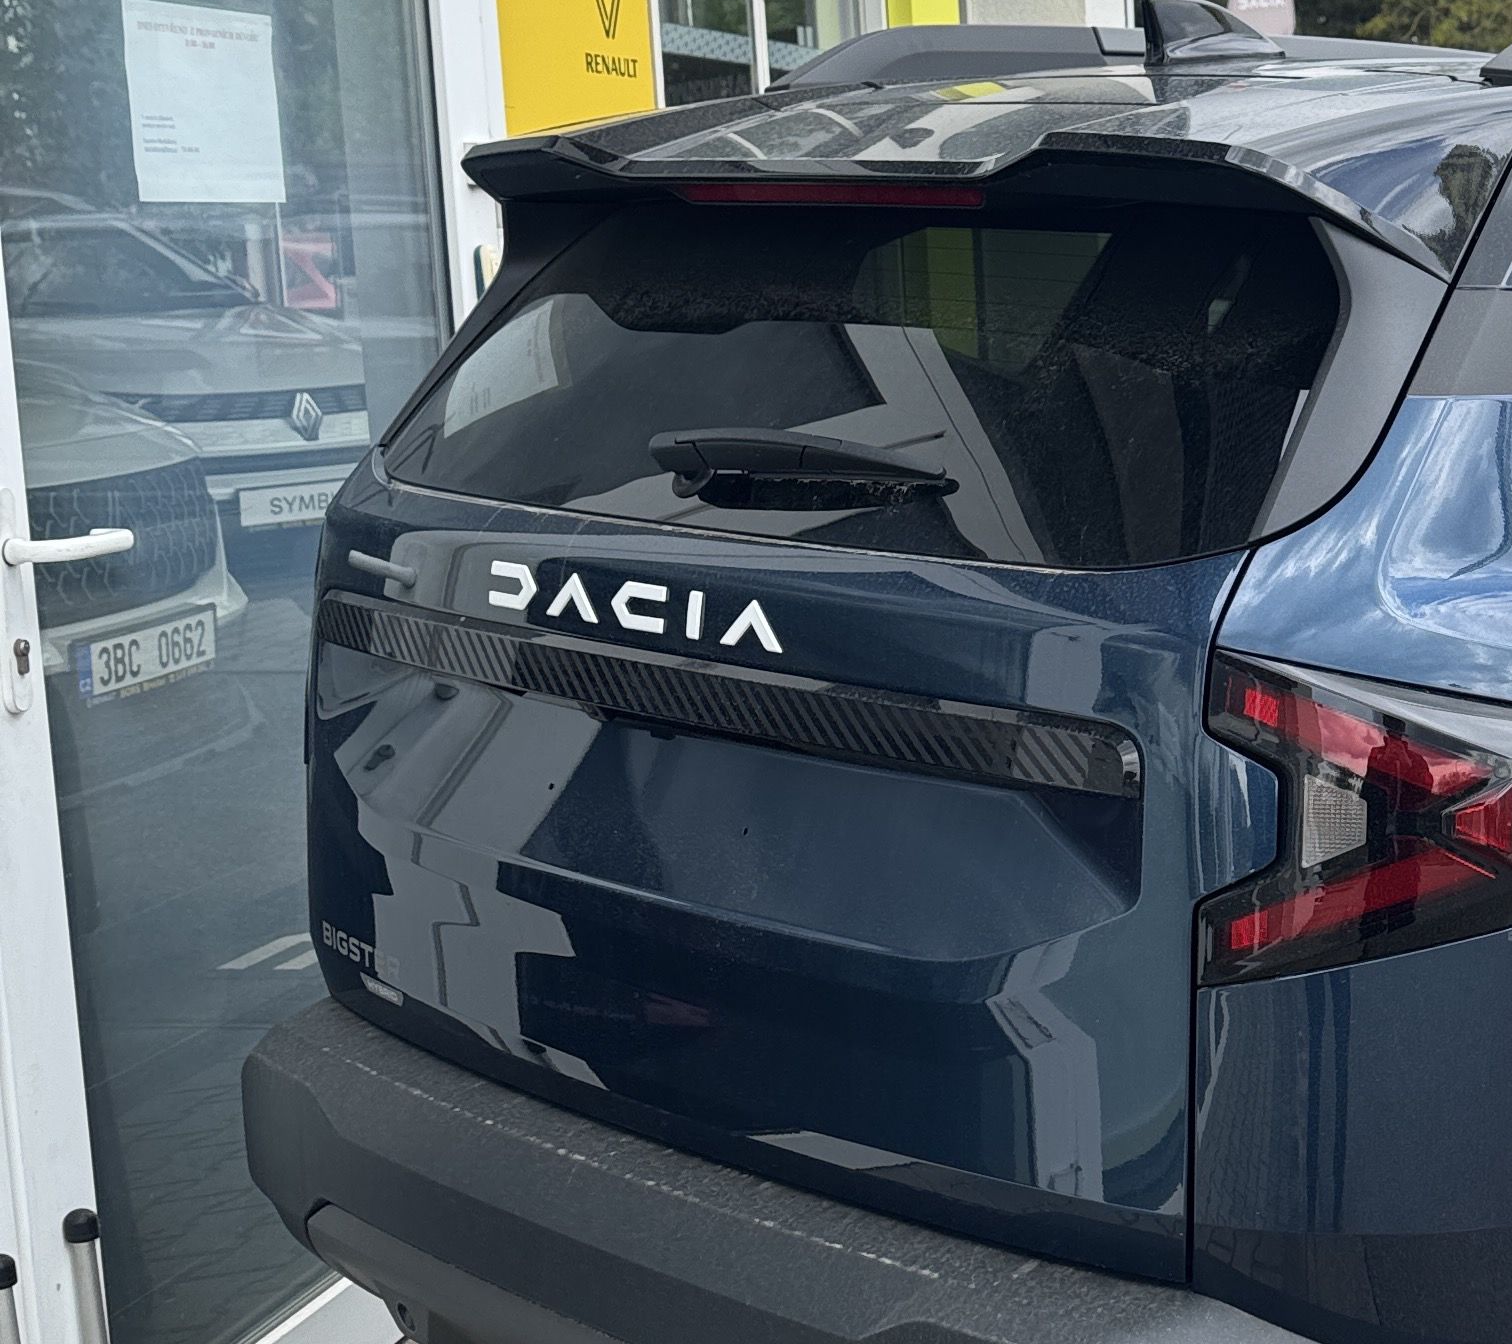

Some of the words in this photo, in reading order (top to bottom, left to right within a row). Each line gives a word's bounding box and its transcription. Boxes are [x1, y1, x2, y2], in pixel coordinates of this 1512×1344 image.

[585, 52, 638, 78] RENAULT
[488, 559, 784, 654] DACIA
[98, 638, 142, 687] 3BC
[157, 619, 207, 669] 0662
